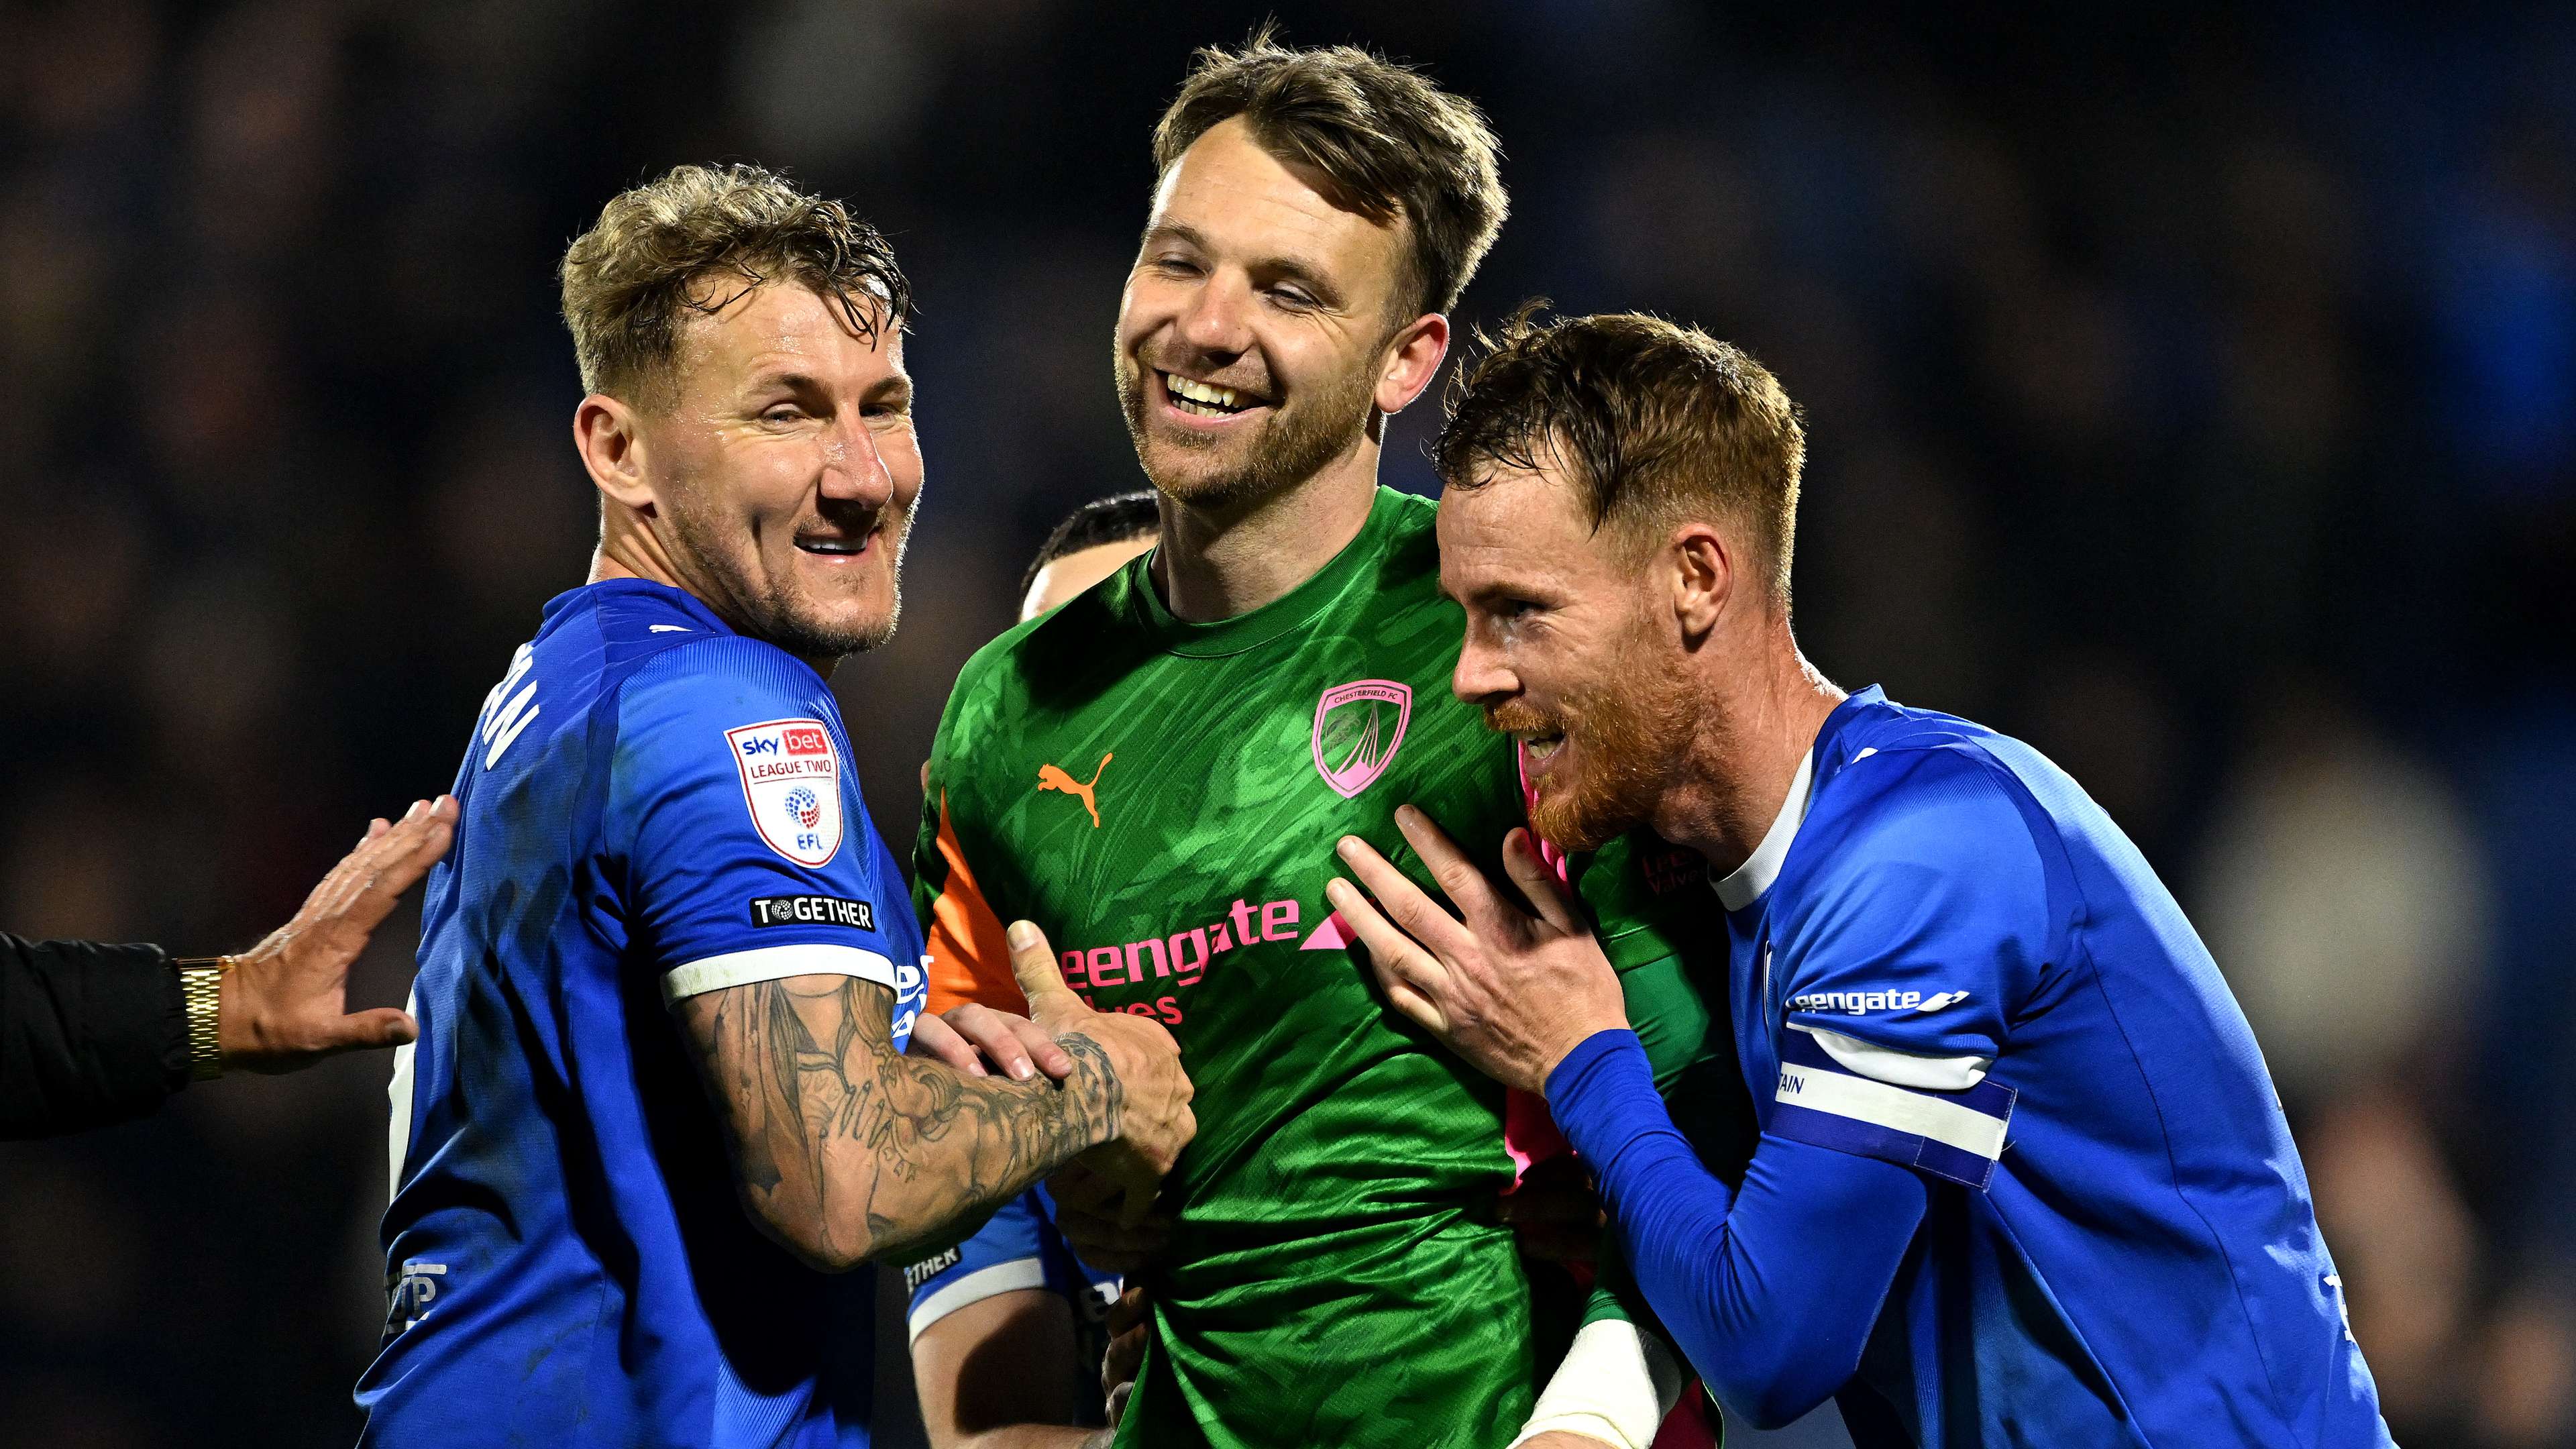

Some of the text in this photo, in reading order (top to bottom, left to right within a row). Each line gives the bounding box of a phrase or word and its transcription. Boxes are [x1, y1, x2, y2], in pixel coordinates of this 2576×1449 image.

[1334, 690, 1387, 704] CHESTERFIELD
[743, 733, 821, 756] sky bet
[751, 759, 831, 779] LEAGUE TWO
[797, 833, 823, 851] EFL
[1061, 899, 1299, 989] eengate
[1780, 1073, 1805, 1094] AIN
